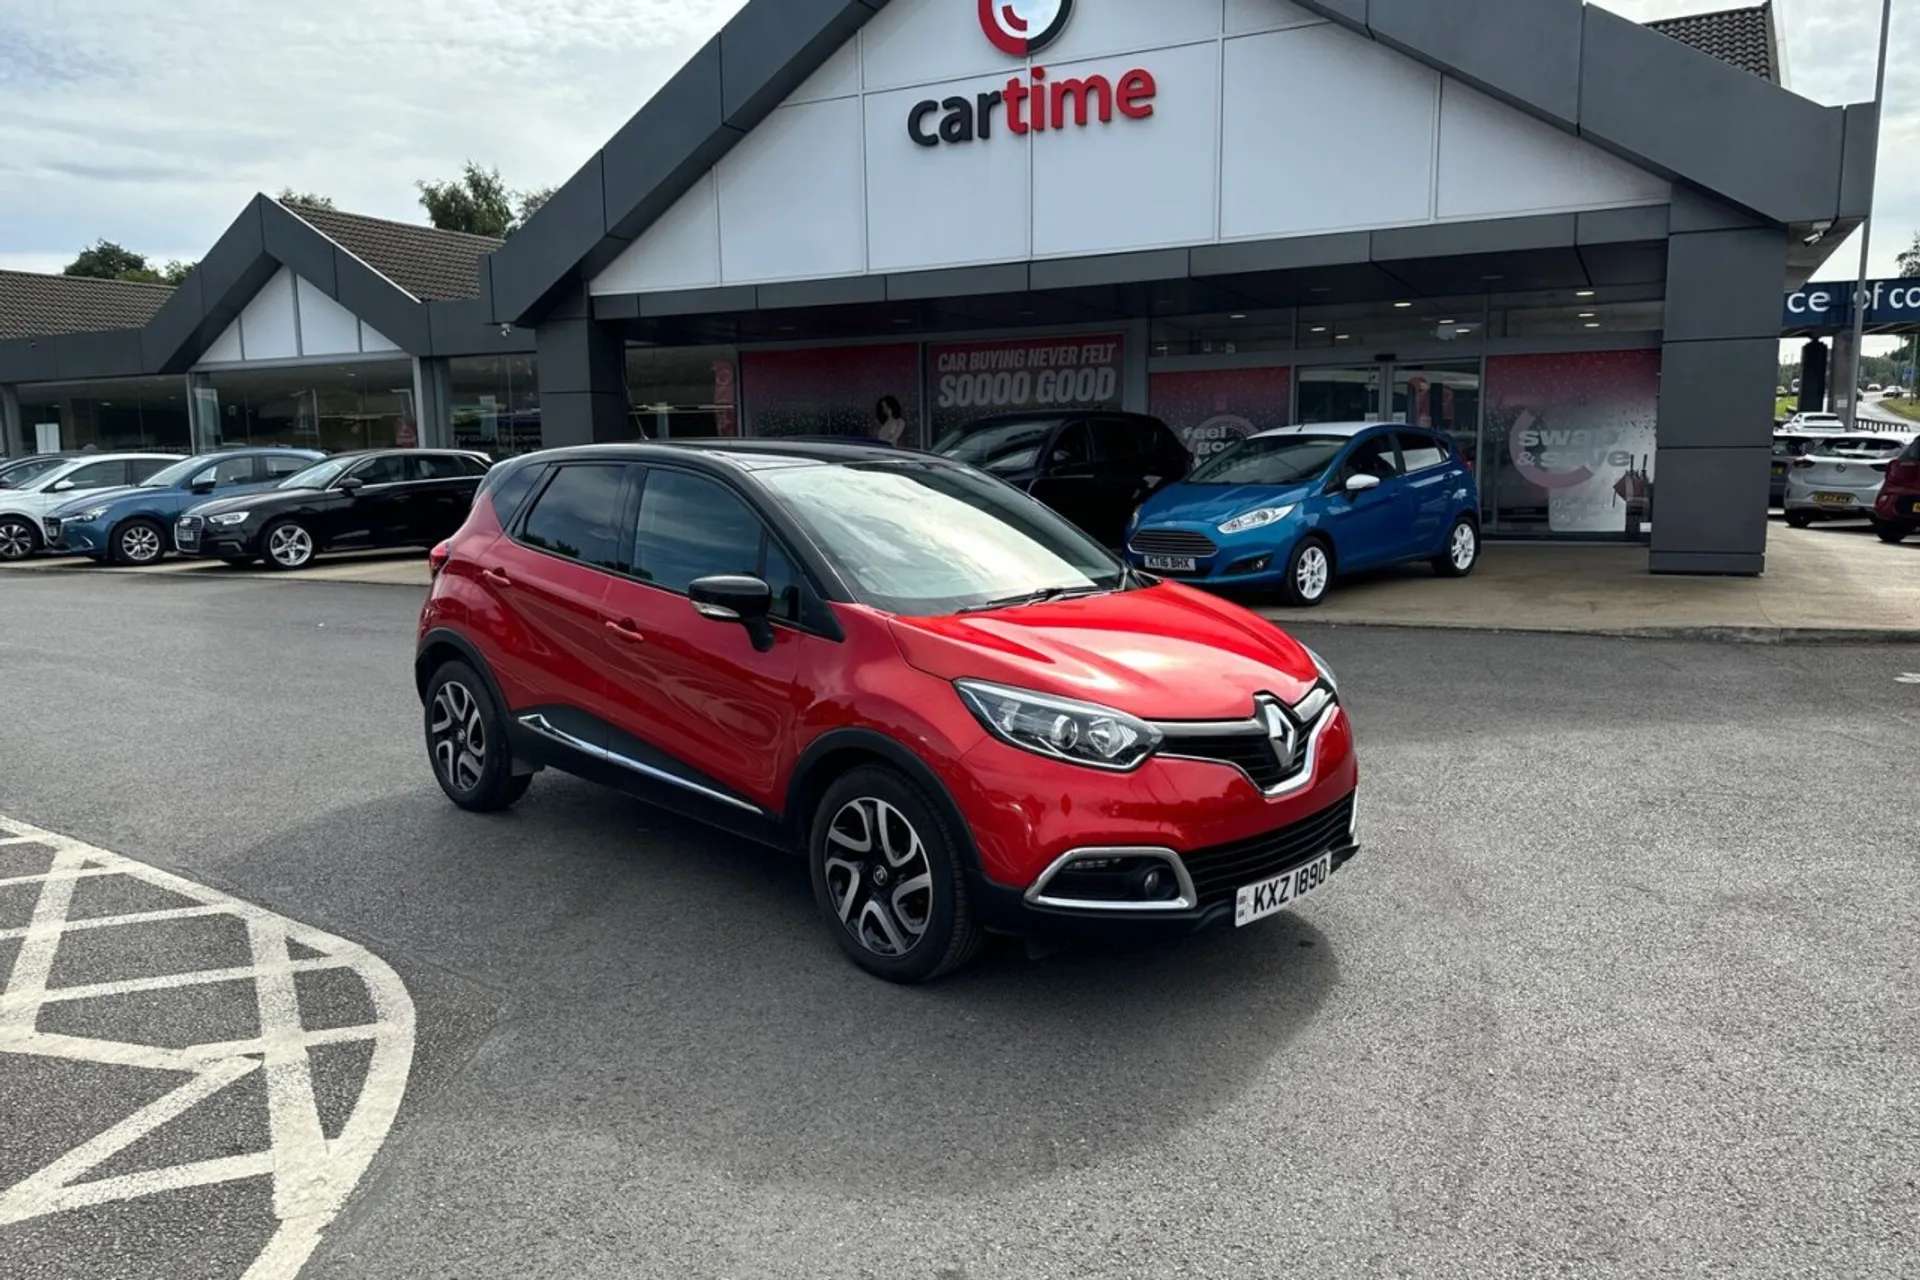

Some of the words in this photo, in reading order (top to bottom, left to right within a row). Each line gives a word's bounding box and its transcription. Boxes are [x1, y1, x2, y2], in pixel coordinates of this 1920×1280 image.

[907, 66, 1157, 147] cartime
[938, 352, 967, 372] CAR
[969, 349, 1026, 370] BUYING
[1027, 345, 1079, 367] NEVER
[1080, 343, 1117, 365] FELT
[938, 370, 1031, 408] SOOOO
[1035, 367, 1117, 404] GOOD
[1253, 875, 1291, 914] KXZ
[1294, 858, 1328, 898] 1890
